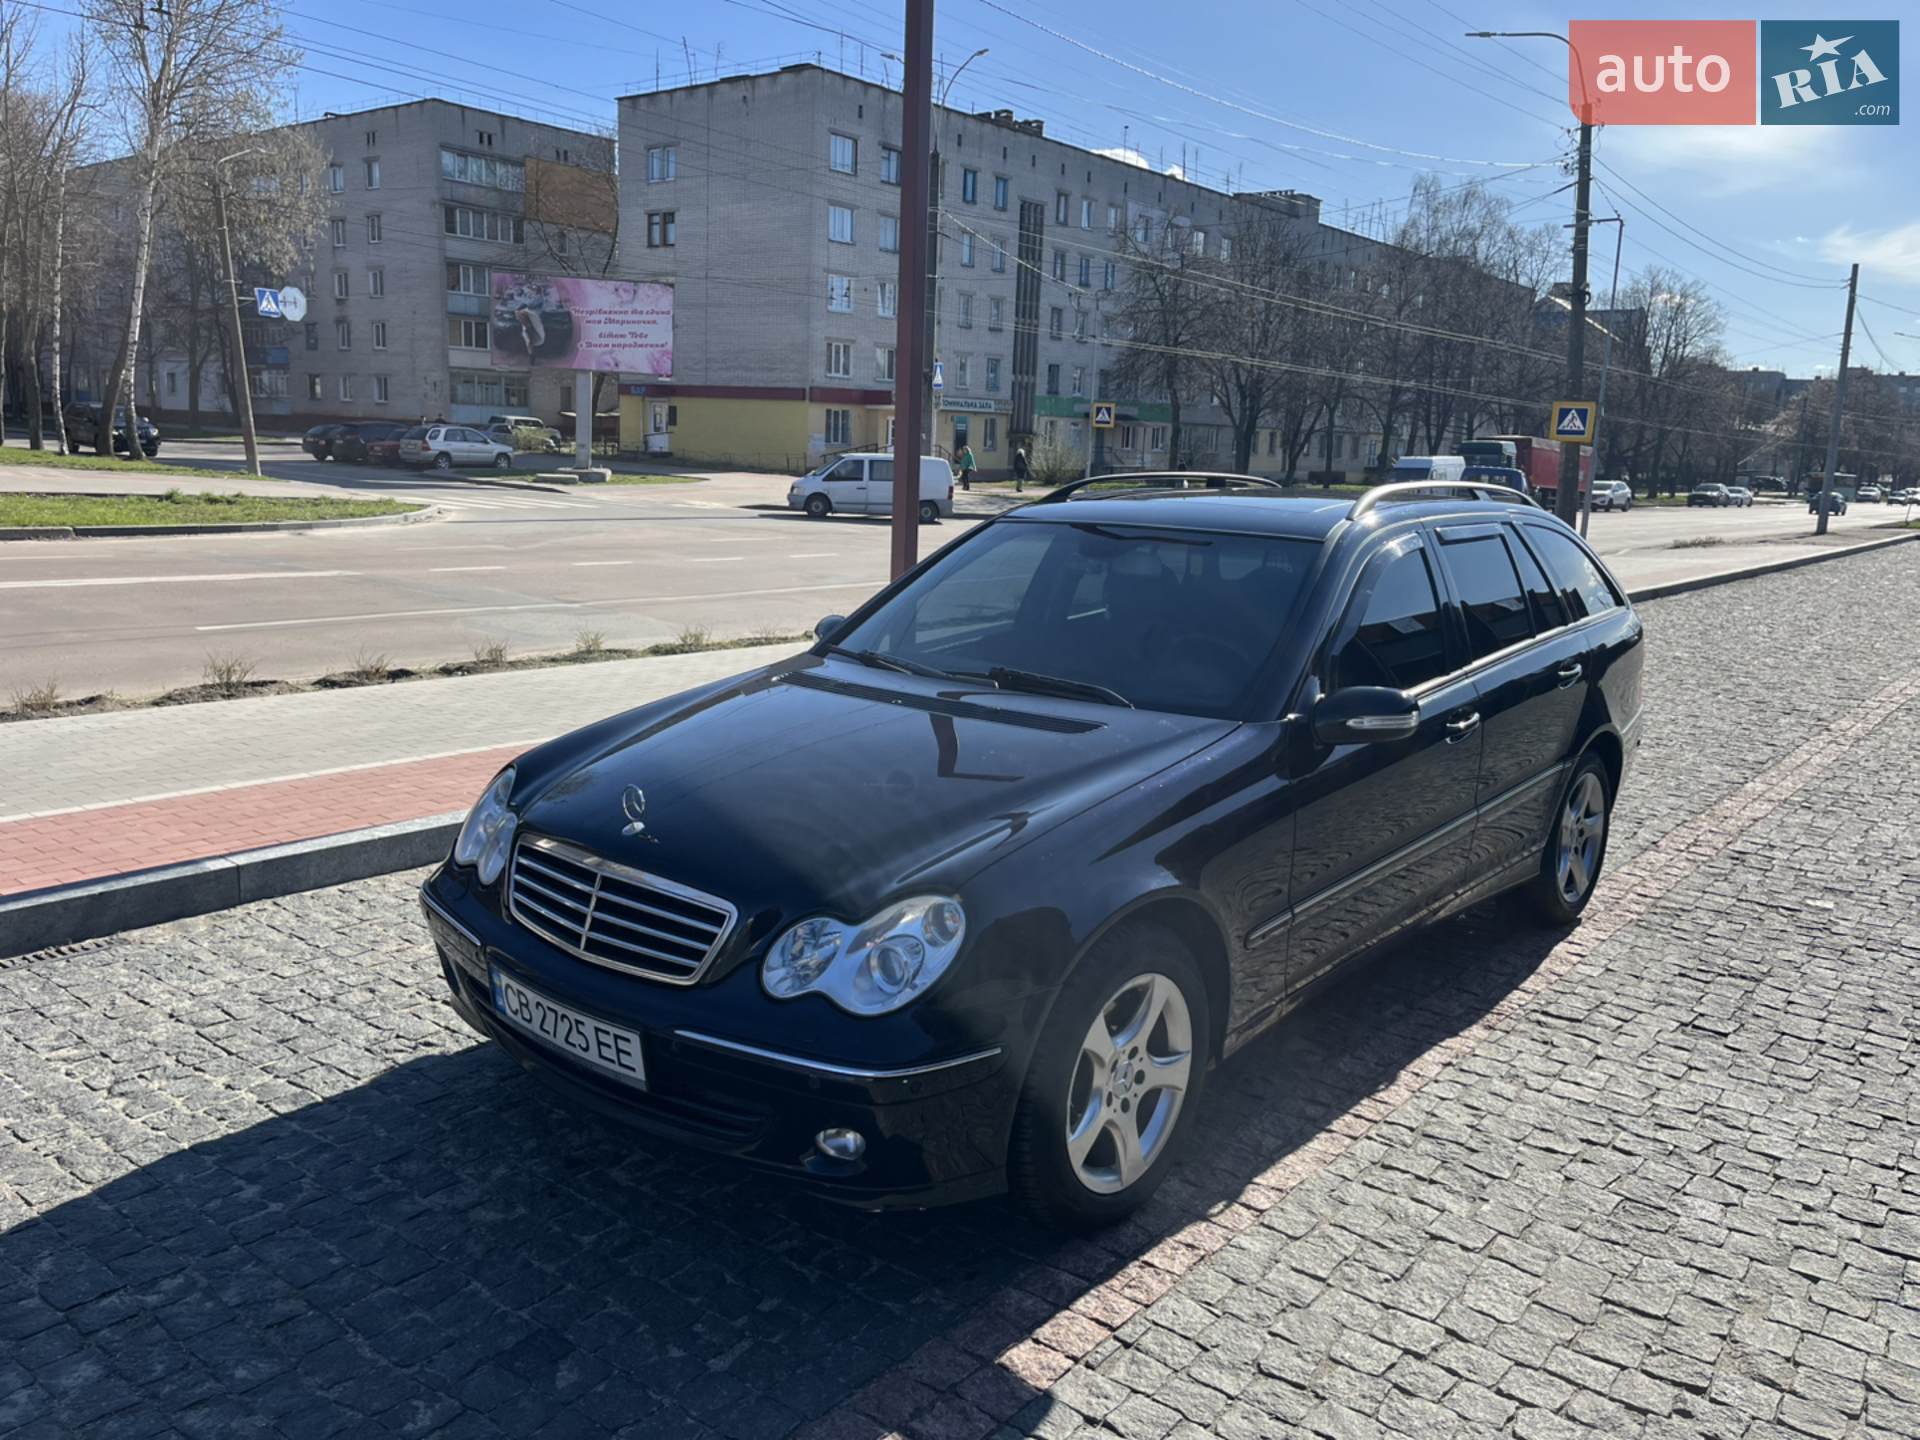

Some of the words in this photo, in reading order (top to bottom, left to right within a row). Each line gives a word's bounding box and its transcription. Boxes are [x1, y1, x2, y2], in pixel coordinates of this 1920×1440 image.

[942, 400, 978, 409] ОМИНАЛЬНА
[504, 983, 533, 1025] CB
[535, 1001, 590, 1053] 2725
[593, 1025, 637, 1073] EE
